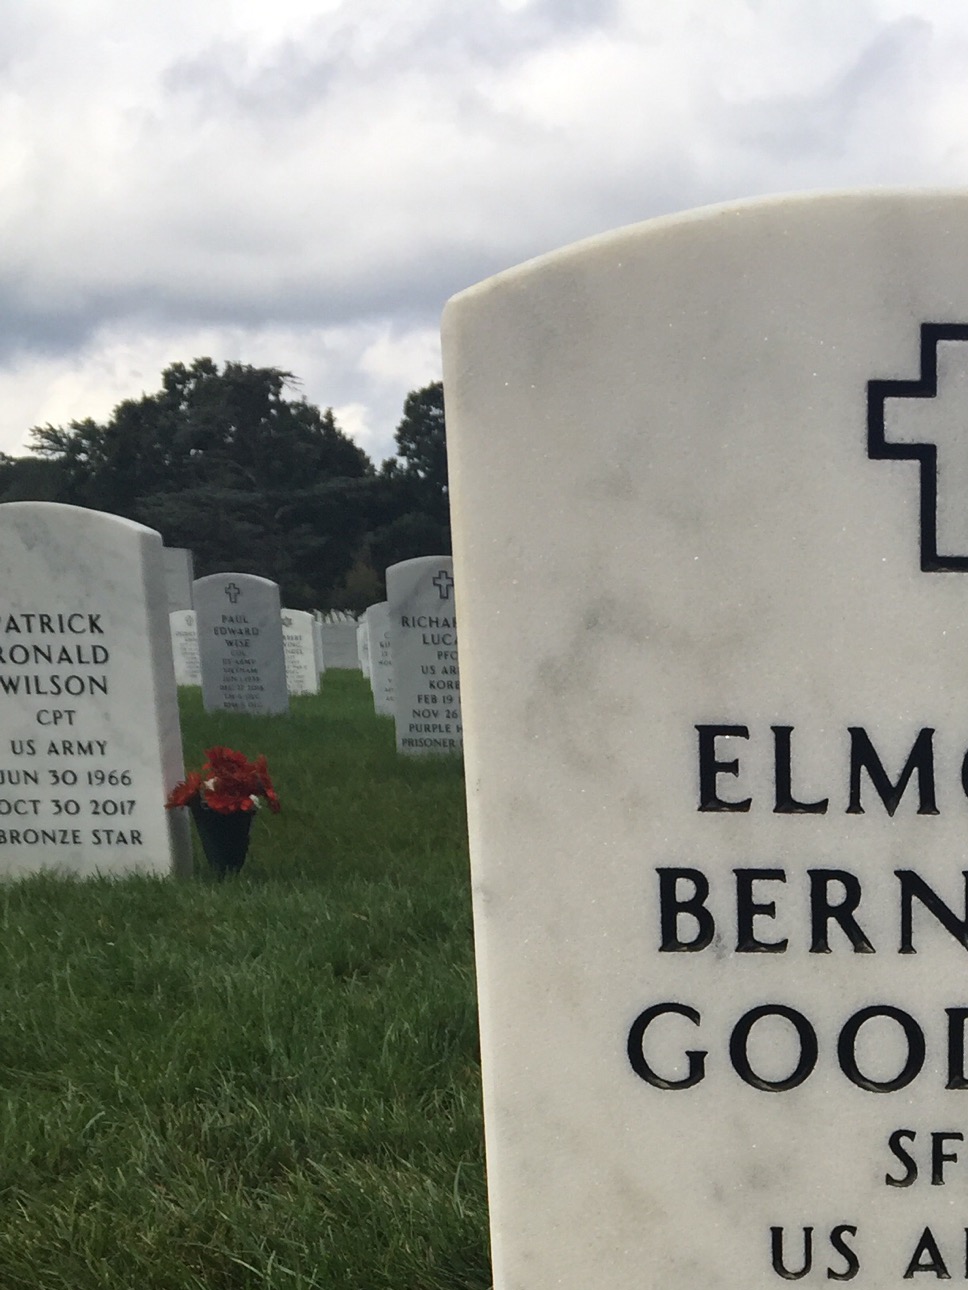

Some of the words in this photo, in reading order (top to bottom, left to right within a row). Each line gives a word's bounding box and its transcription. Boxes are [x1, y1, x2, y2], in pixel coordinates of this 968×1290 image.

[0, 614, 103, 633] ATRICK
[222, 614, 248, 624] PAUL
[214, 626, 259, 636] EDWARD
[225, 639, 250, 647] WISE
[421, 665, 436, 675] US
[441, 665, 459, 675] AR
[0, 675, 107, 695] WILSON
[429, 680, 459, 689] KORE
[417, 695, 437, 704] FEB
[442, 695, 453, 704] 19
[37, 710, 75, 725] CPT
[412, 709, 439, 719] NOV
[445, 709, 458, 719] 26
[409, 723, 451, 733] PURPLE
[11, 740, 36, 755] US
[48, 740, 105, 755] ARMY
[402, 738, 455, 747] PRISONER
[0, 770, 38, 785] JUN
[49, 770, 77, 785] 30
[88, 770, 131, 786] 1966
[0, 799, 40, 815] OCT
[51, 800, 80, 815] 30
[90, 800, 135, 815] 2017
[0, 829, 81, 844] BRONZE
[92, 830, 142, 845] STAR
[770, 1225, 860, 1281] US
